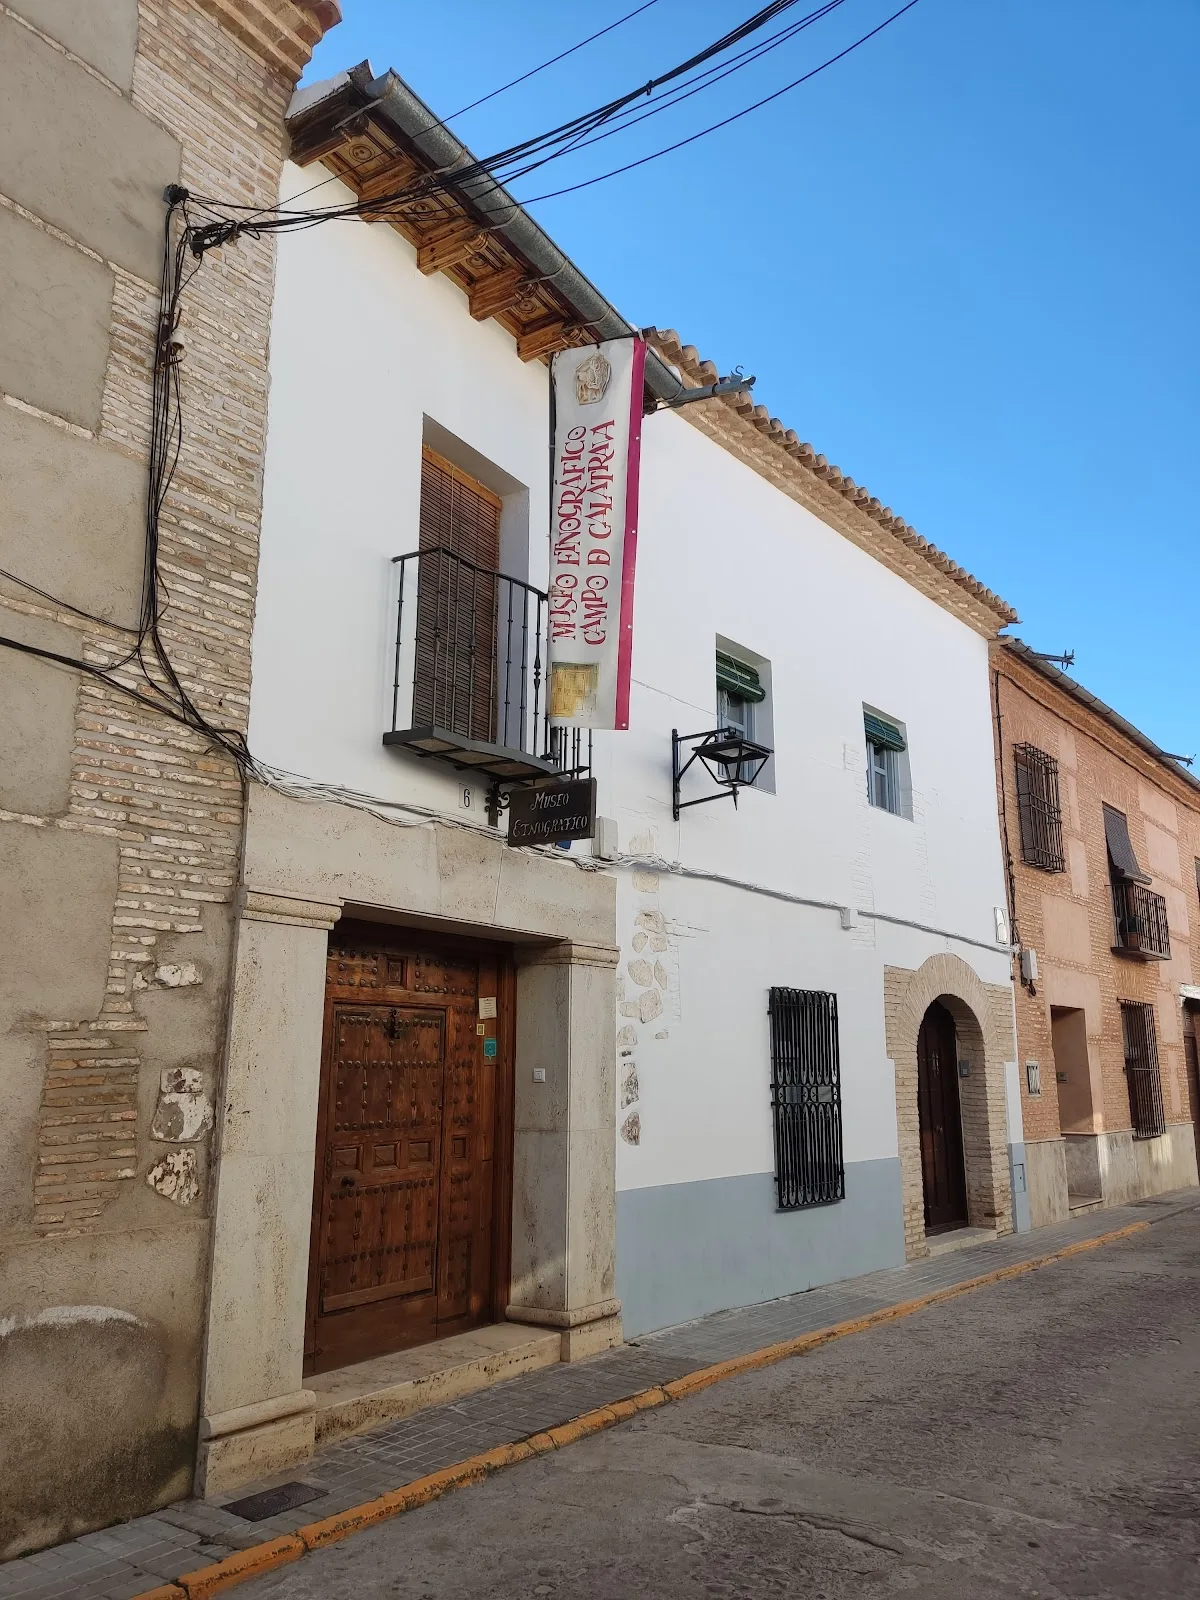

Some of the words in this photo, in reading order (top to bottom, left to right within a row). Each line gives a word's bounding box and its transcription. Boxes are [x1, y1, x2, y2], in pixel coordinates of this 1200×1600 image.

[584, 419, 615, 540] CALATRAVA
[550, 573, 579, 644] MUSEO
[580, 575, 608, 646] CAMPO
[463, 788, 471, 808] 6
